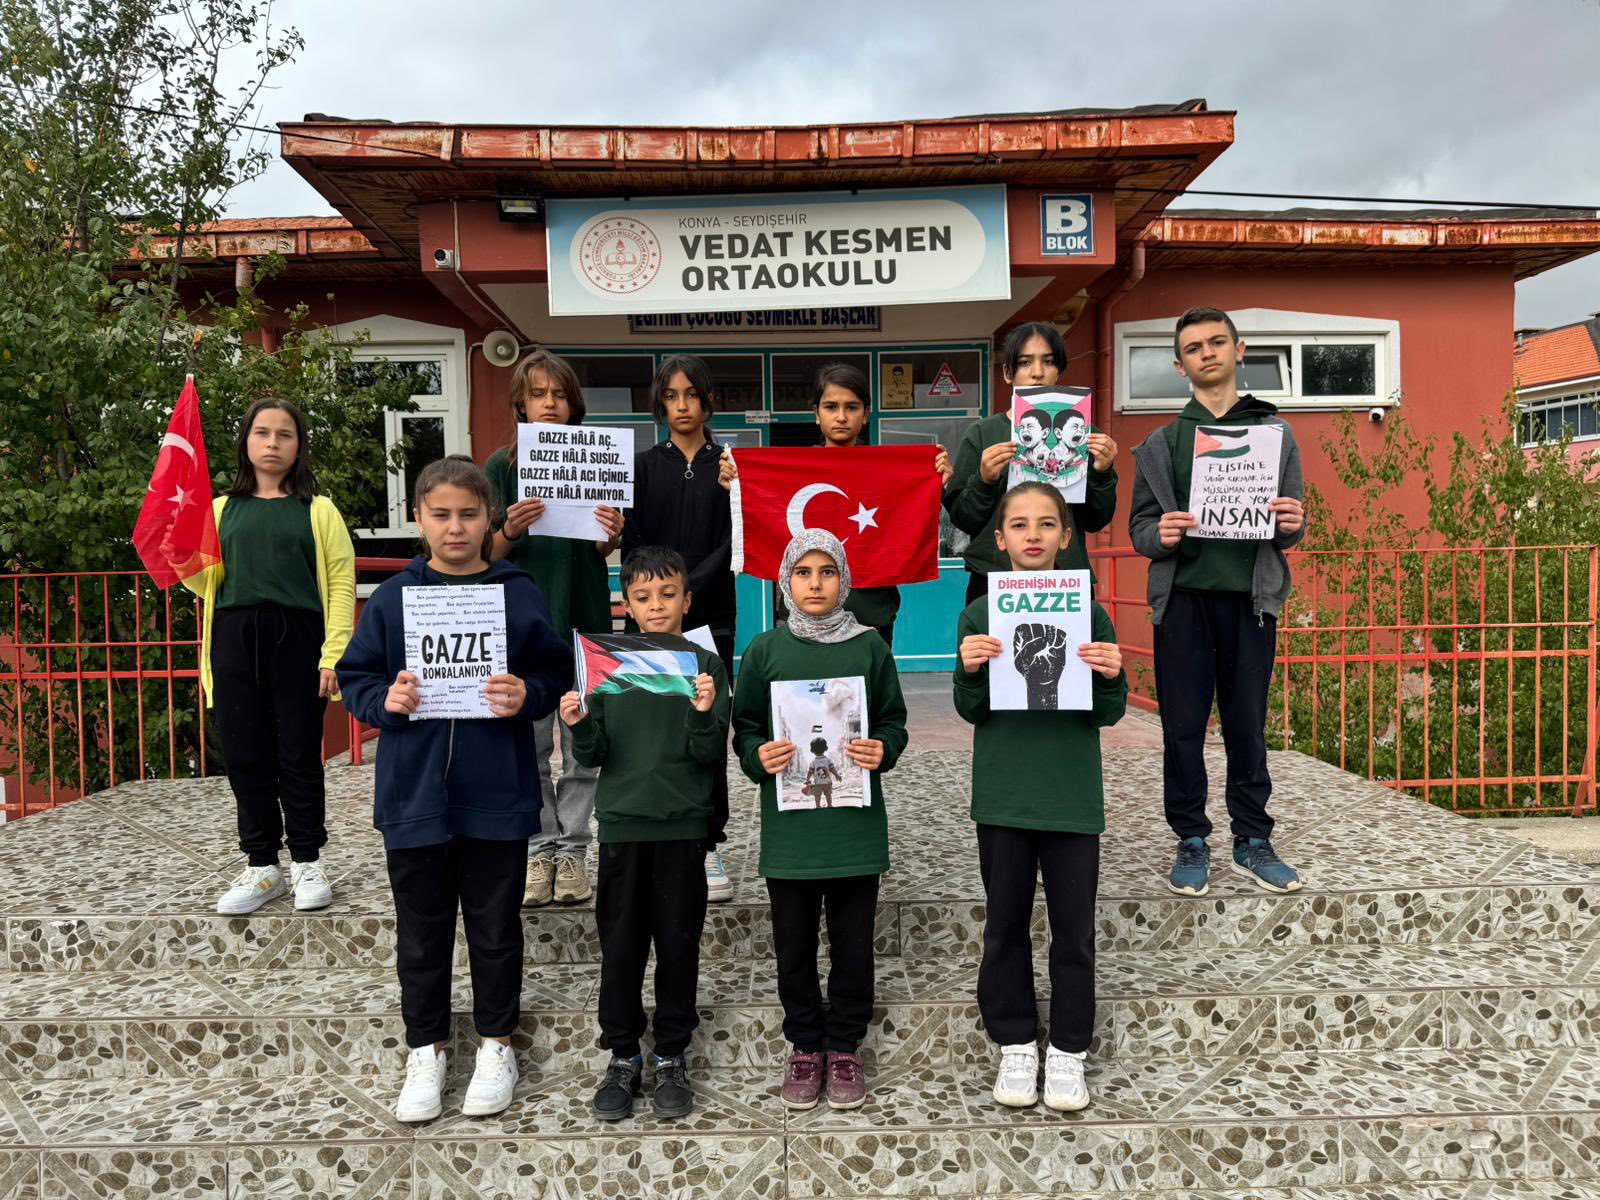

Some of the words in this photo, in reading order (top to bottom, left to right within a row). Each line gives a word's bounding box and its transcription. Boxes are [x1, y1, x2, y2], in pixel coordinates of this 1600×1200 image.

[678, 217, 721, 229] KONYA
[733, 212, 807, 228] SEYDİŞEHİR
[1046, 199, 1087, 234] B
[679, 231, 793, 260] VEDAT
[804, 225, 952, 256] KESMEN
[1046, 236, 1088, 250] BLOK
[681, 259, 897, 292] ORTAOKULU
[538, 431, 568, 445] GAZZE
[571, 430, 596, 446] HÂLÂ
[598, 434, 617, 450] AÇ..
[530, 449, 559, 462] GAZZE
[562, 448, 587, 464] HÂLÂ
[590, 452, 625, 466] SUSUZ..
[520, 467, 549, 480] GAZZE
[552, 466, 577, 482] HÂLÂ
[580, 469, 596, 482] ACI
[599, 468, 635, 486] İÇİNDE..
[524, 486, 554, 499] GAZZE
[557, 484, 581, 500] HÂLÂ
[584, 488, 630, 502] KANIYOR..
[1250, 495, 1270, 505] YOK
[1201, 502, 1272, 528] İNSAN
[1198, 528, 1228, 538] OLMAK
[998, 577, 1057, 590] DİRENİŞİN
[1059, 578, 1080, 588] ADI
[997, 592, 1081, 613] GAZZE
[421, 632, 493, 664] GAZZE
[422, 664, 492, 680] BOMBALANIYOR
